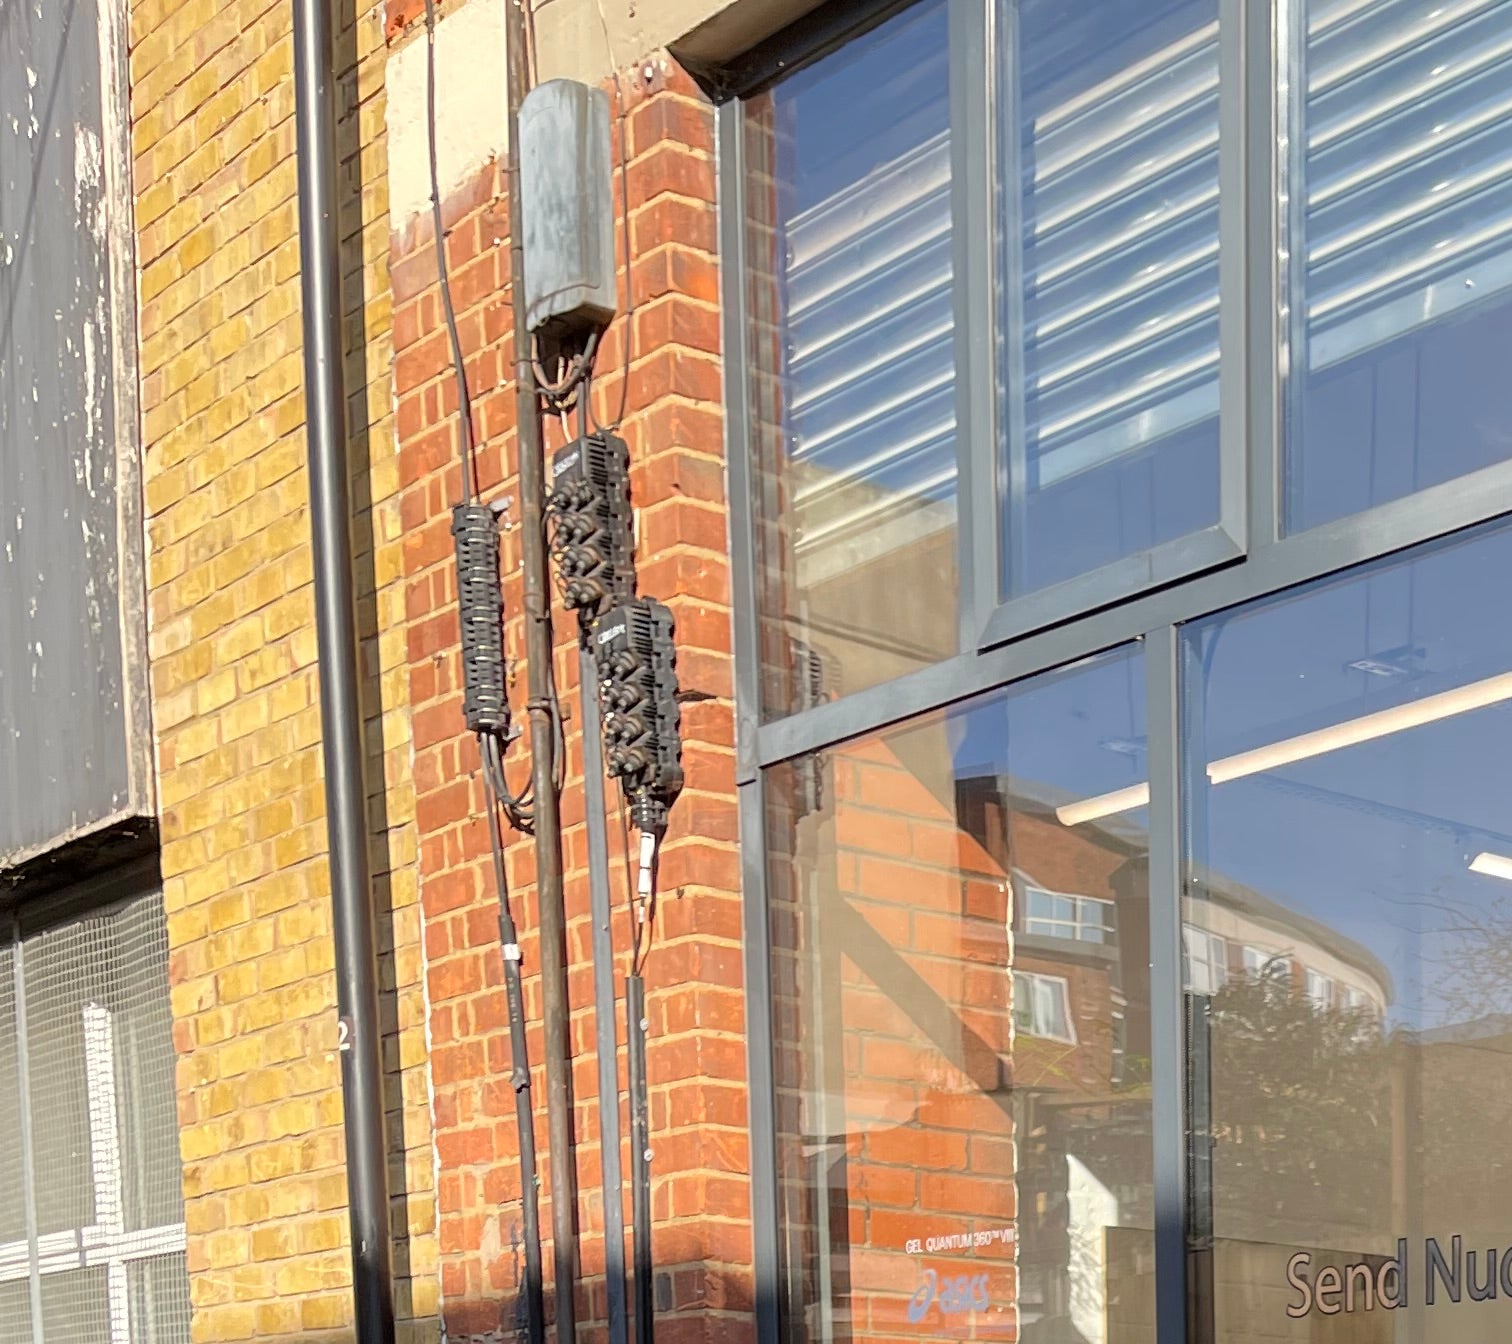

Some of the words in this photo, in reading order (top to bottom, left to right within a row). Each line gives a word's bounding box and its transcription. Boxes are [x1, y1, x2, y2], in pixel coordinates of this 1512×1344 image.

[905, 1238, 923, 1255] GEL
[925, 1233, 972, 1252] QUANTUM
[1286, 1237, 1408, 1319] Send
